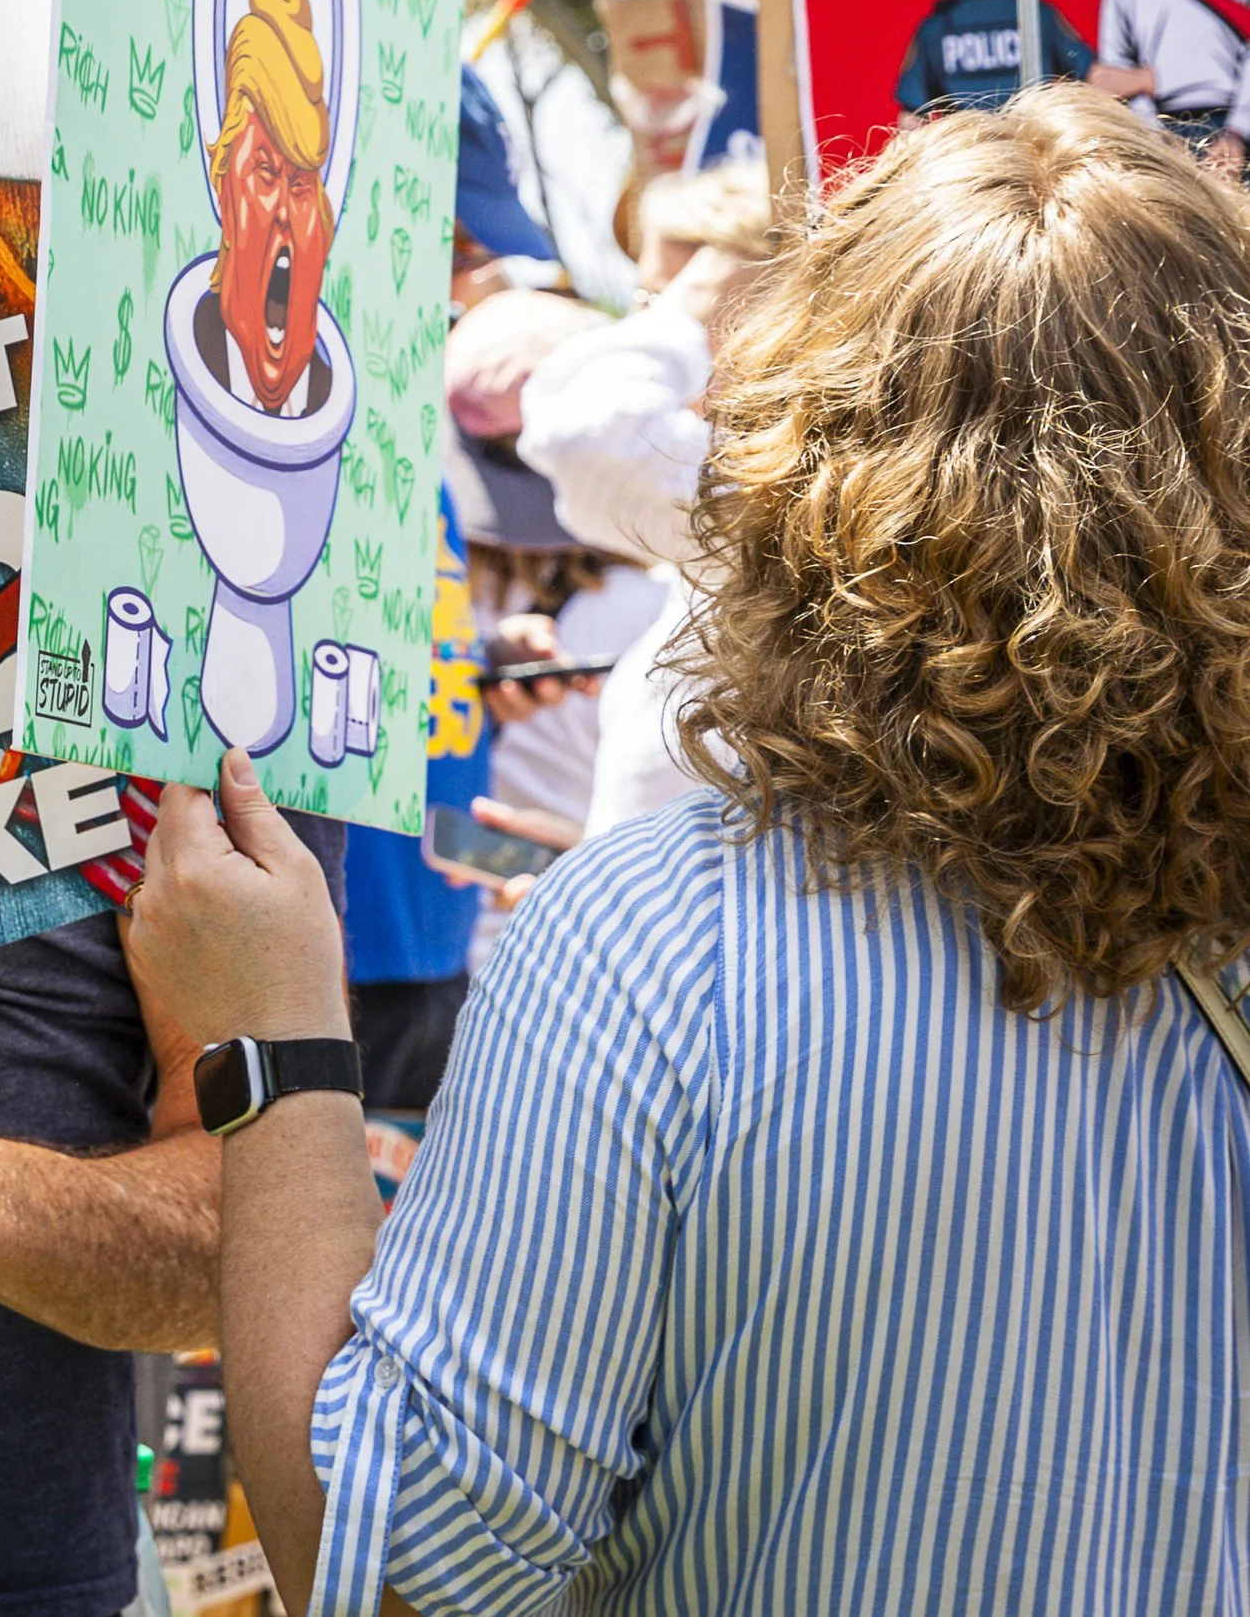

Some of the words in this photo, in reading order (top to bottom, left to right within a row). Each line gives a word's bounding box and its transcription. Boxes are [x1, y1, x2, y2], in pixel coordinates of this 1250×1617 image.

[81, 176, 109, 228] NO
[58, 435, 85, 487] NO
[40, 659, 63, 678] STAND
[63, 663, 72, 679] UP
[72, 666, 82, 681] TO
[39, 677, 90, 717] STUPID
